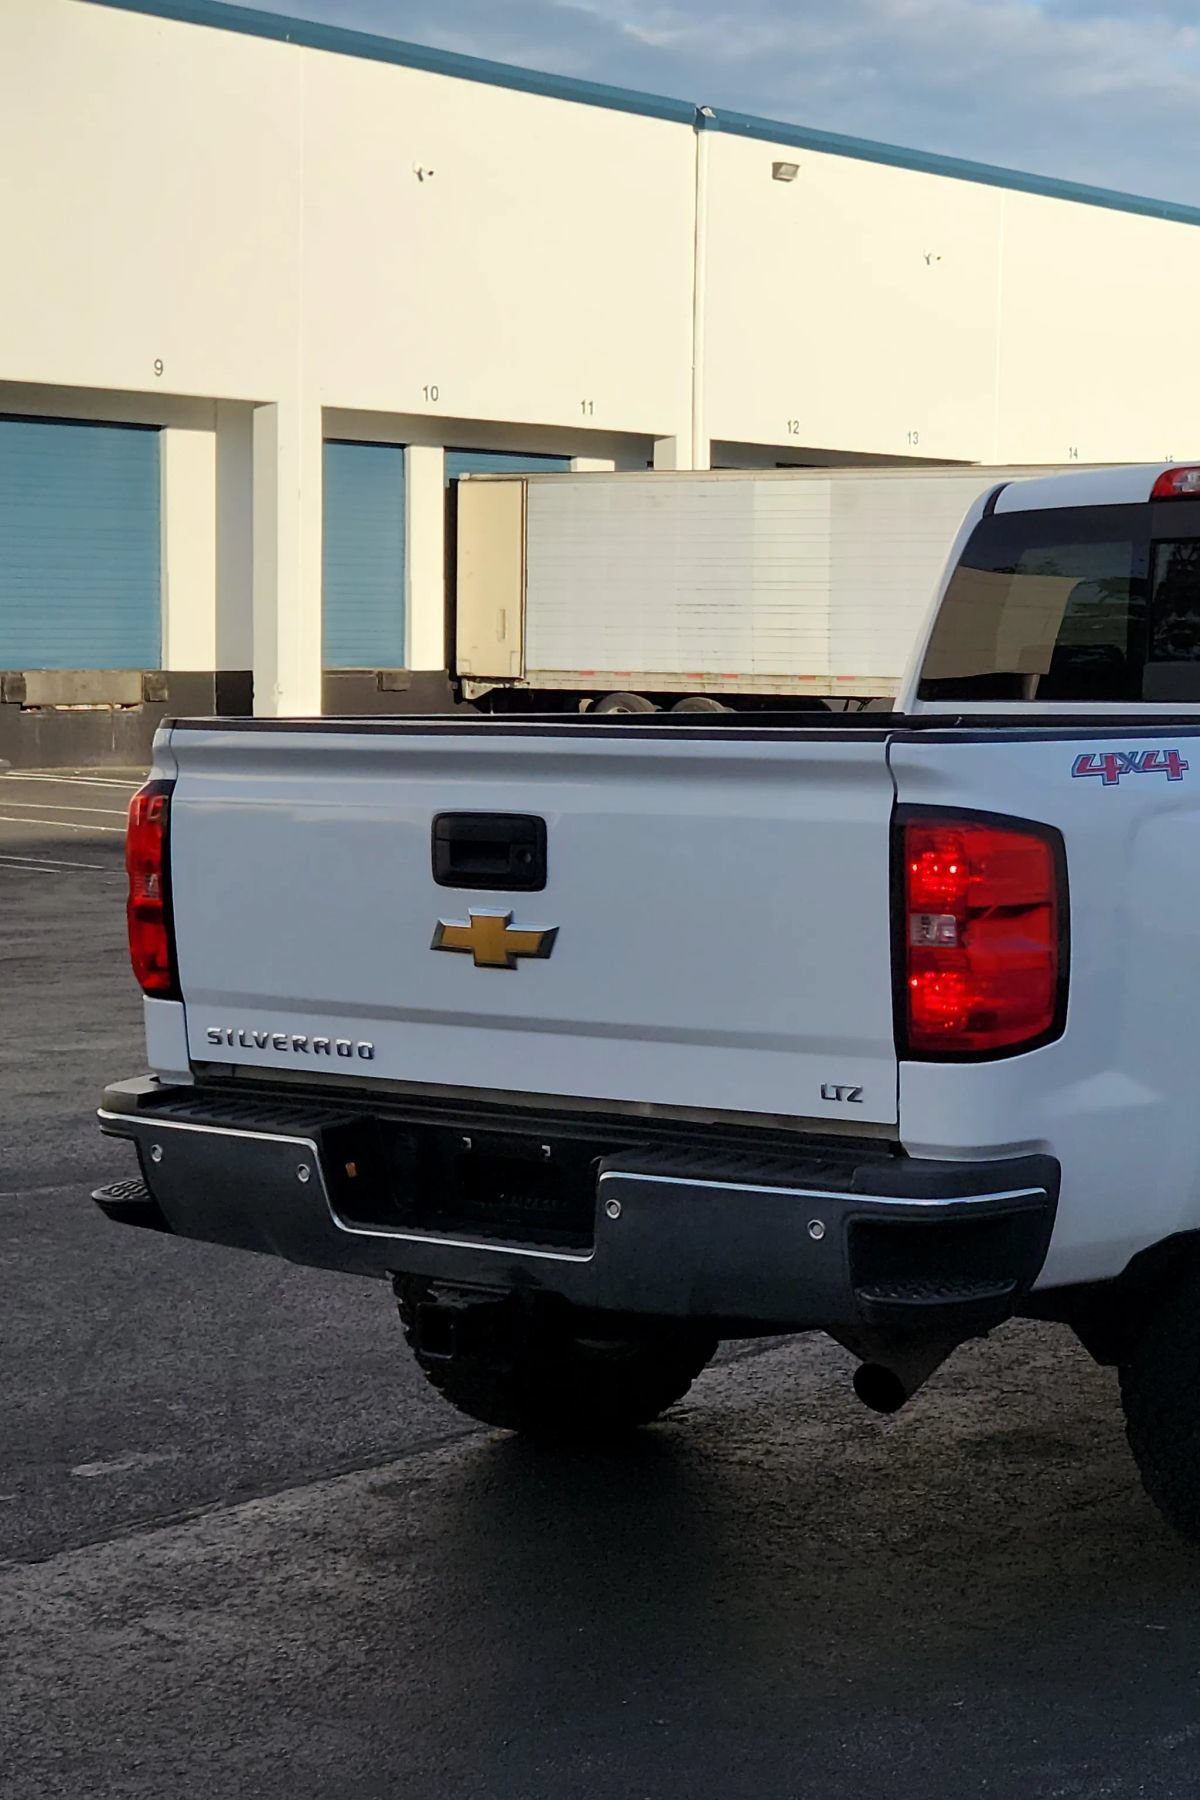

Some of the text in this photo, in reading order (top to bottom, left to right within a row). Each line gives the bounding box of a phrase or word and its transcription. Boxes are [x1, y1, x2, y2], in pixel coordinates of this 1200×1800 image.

[153, 358, 164, 377] 9
[423, 385, 439, 402] 10
[581, 399, 594, 415] 11
[787, 420, 800, 435] 12
[907, 431, 919, 446] 13
[1069, 447, 1078, 460] 14
[206, 1026, 376, 1061] SILVERADO
[820, 1082, 864, 1103] LTZ
